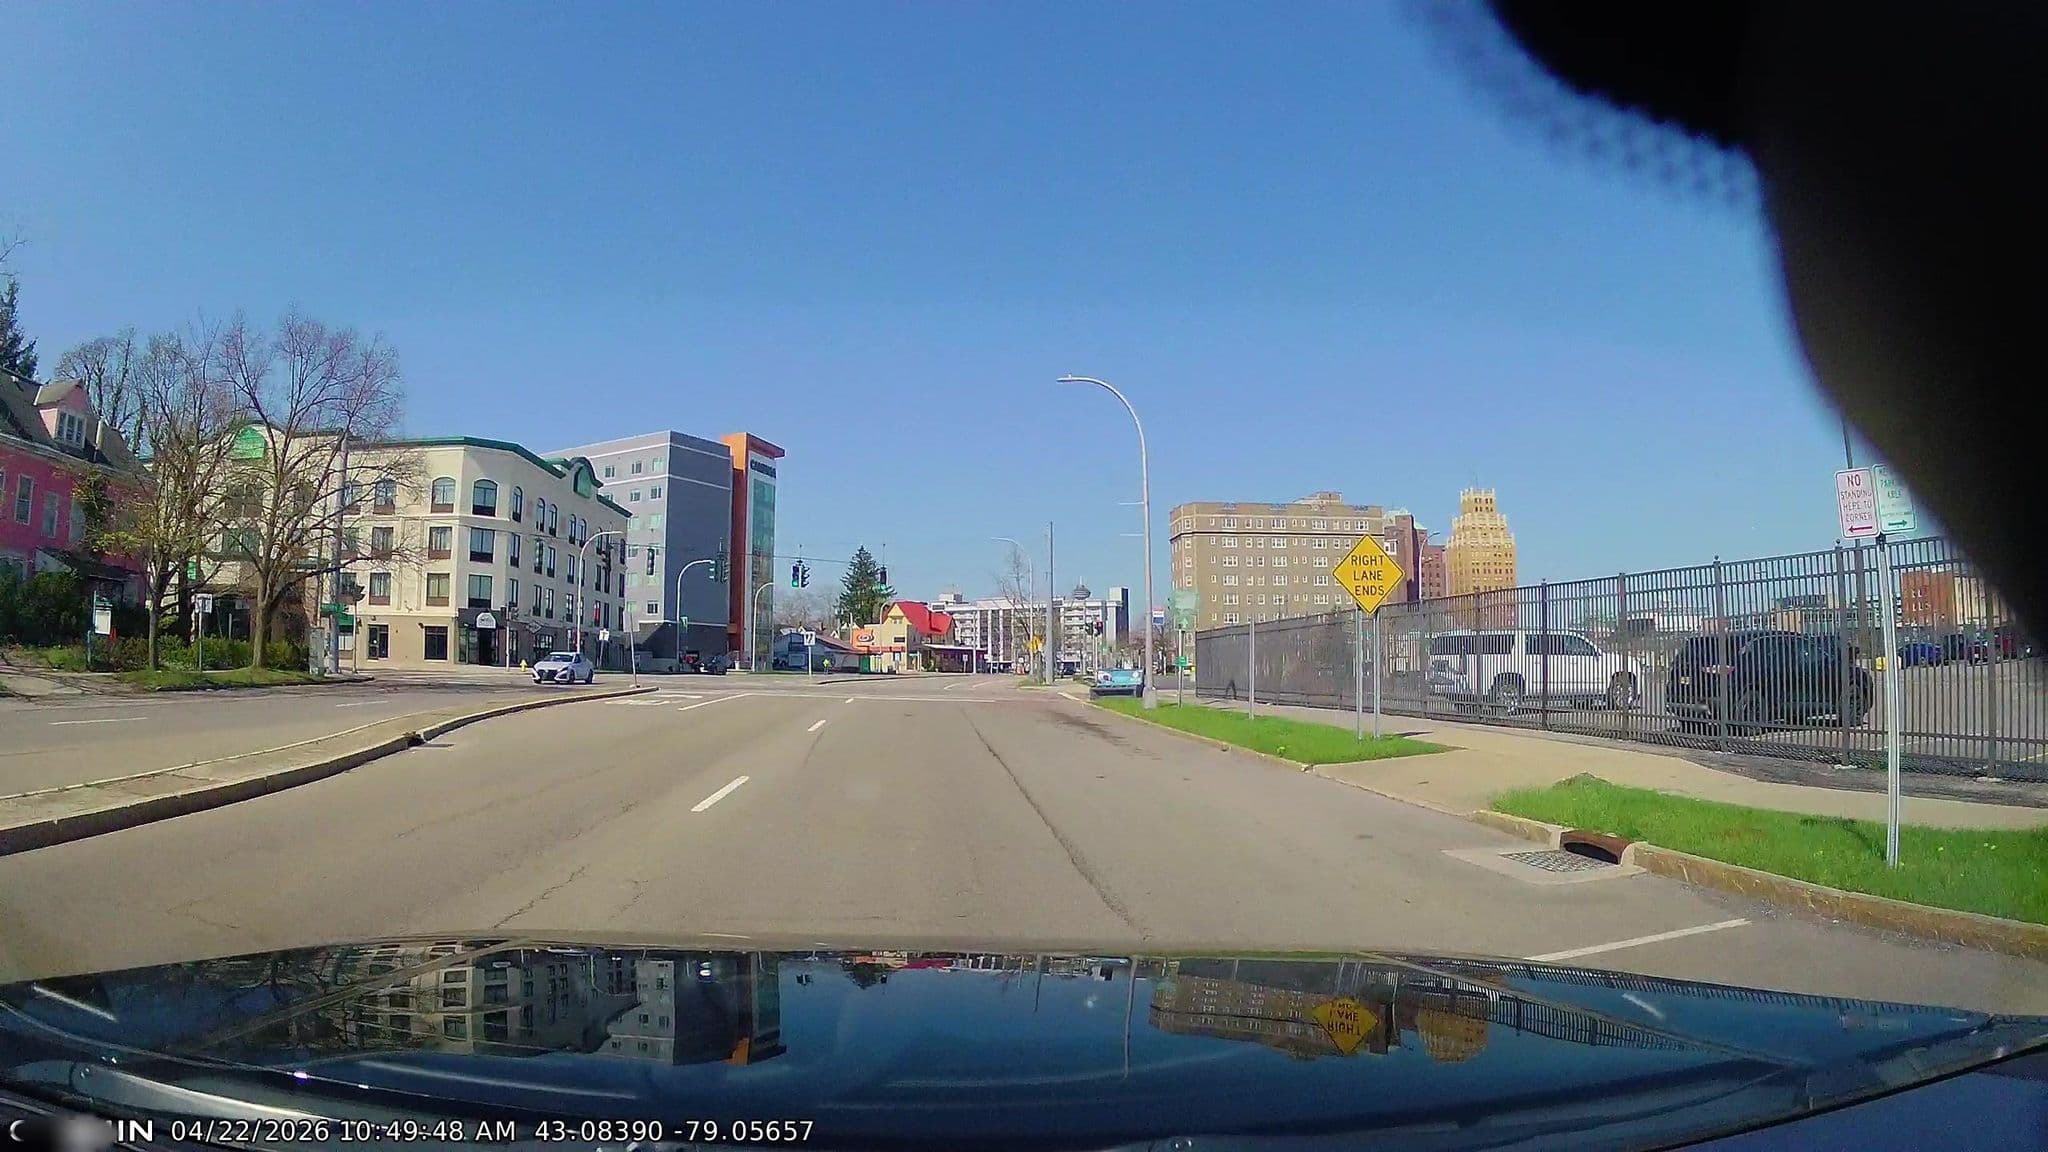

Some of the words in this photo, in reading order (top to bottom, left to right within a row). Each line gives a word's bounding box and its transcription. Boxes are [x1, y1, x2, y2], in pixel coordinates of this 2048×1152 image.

[1847, 474, 1861, 487] NO
[1863, 500, 1872, 509] TO
[1350, 554, 1385, 566] RIGHT
[1353, 570, 1383, 581] LANE
[1355, 585, 1385, 596] ENDS
